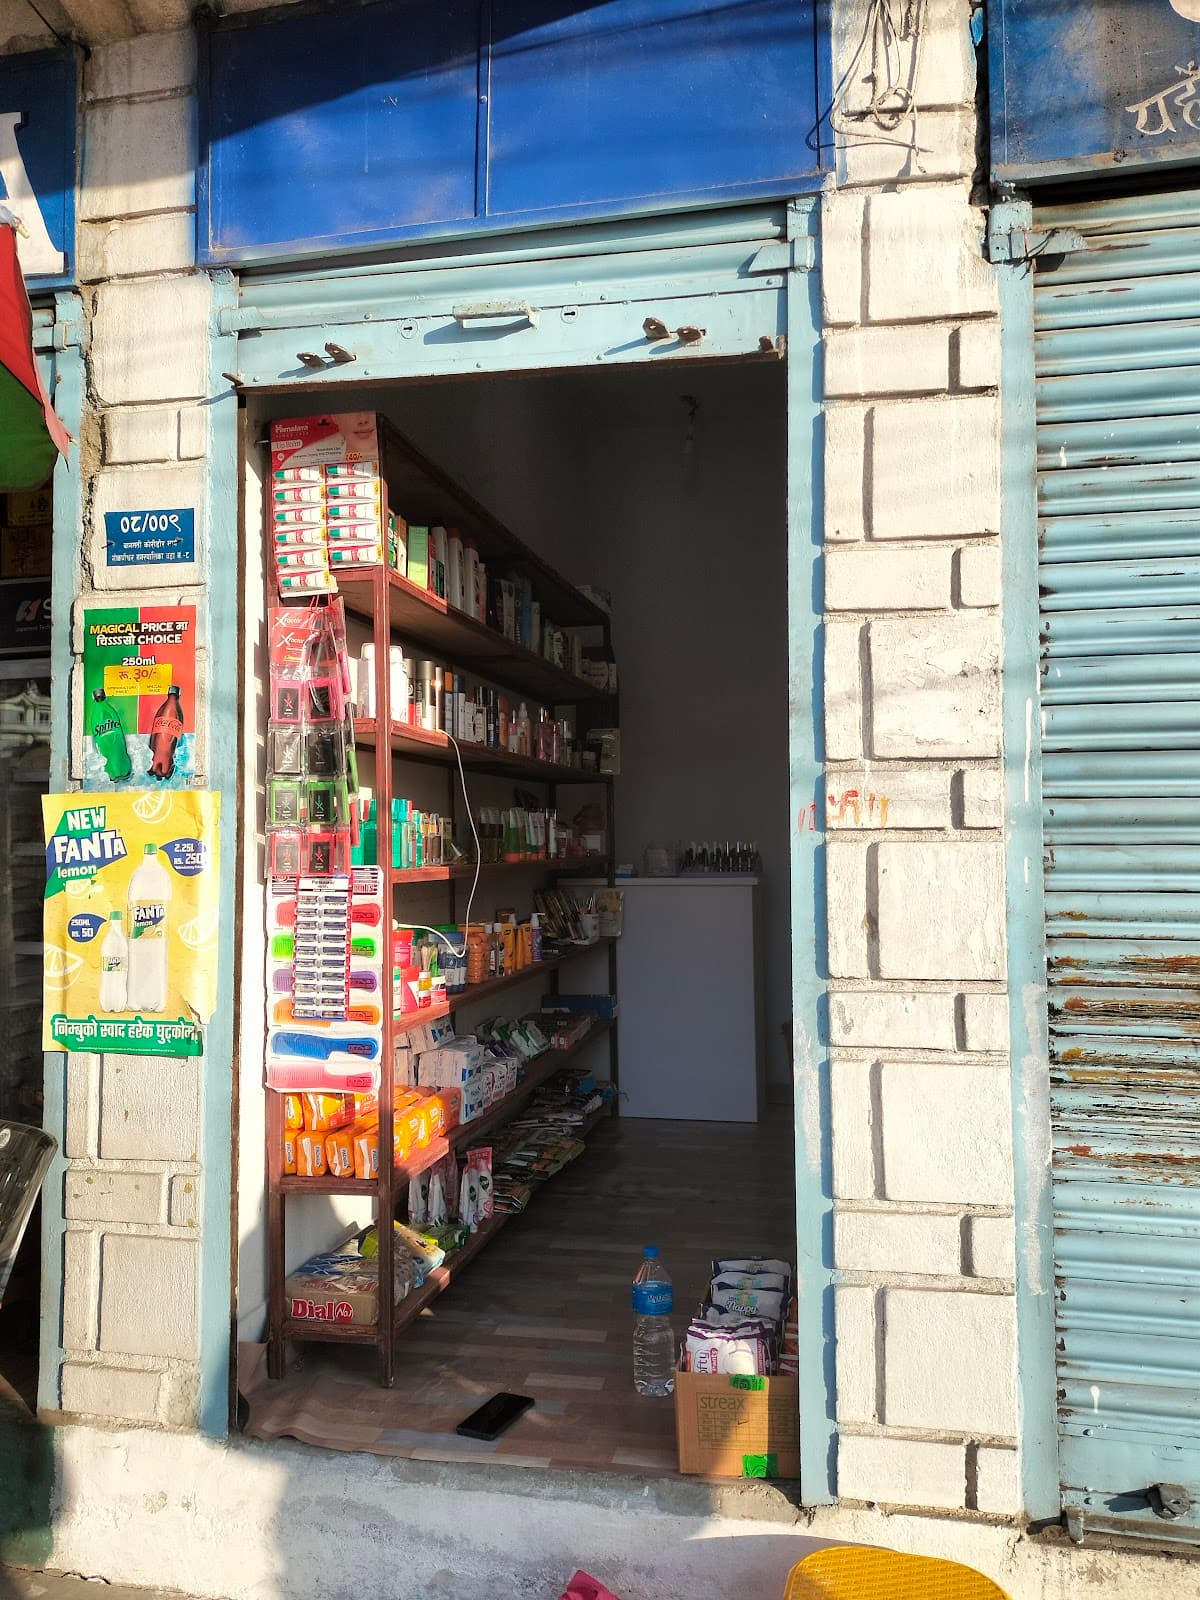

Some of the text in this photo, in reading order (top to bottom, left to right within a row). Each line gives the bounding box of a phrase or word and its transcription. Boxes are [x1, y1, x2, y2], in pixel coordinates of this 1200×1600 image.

[90, 621, 189, 635] MAGICAL PRICE मा
[137, 633, 183, 645] CHOICE
[122, 656, 156, 666] 250ml
[94, 719, 121, 737] Sprite
[66, 807, 105, 831] NEW
[53, 830, 127, 864] FANTA
[57, 865, 97, 879] lemon
[81, 927, 94, 938] 50
[291, 1298, 335, 1321] Dial
[699, 1394, 746, 1410] streax
